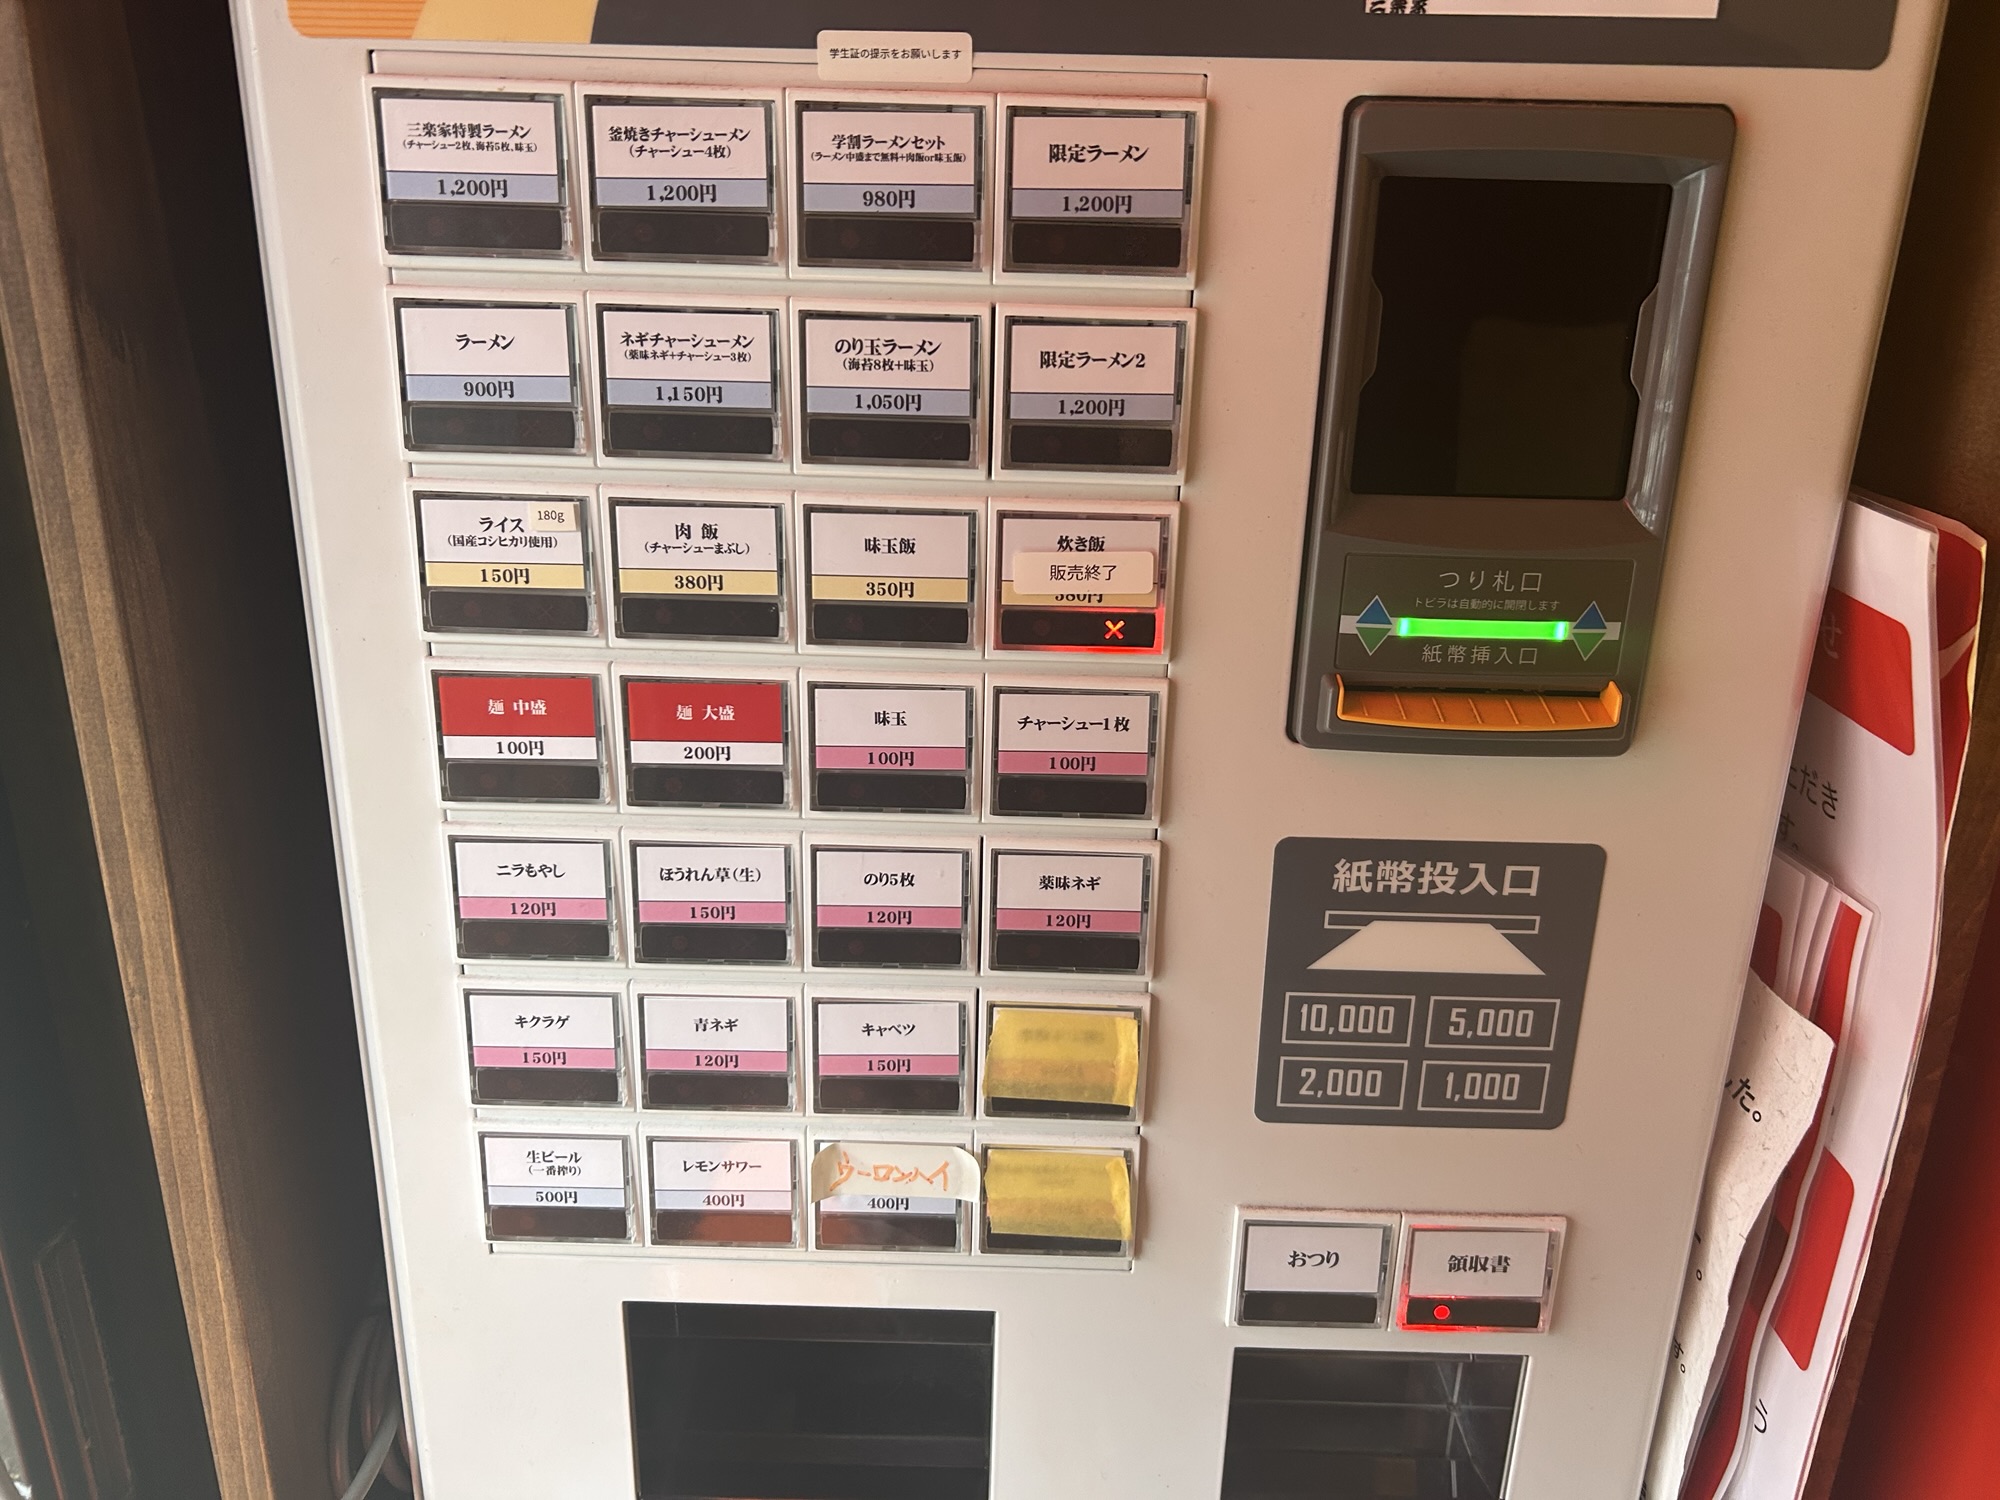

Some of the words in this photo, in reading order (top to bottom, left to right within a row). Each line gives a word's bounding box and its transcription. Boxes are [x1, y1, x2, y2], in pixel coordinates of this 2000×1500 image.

[829, 48, 962, 60] 学生証の提示をお願いします
[407, 122, 532, 141] 三楽家特製ラーメン
[608, 126, 751, 143] 釜焼きチャーシューメン
[831, 134, 947, 150] 学割ラーメンセット
[629, 144, 732, 160] （チャーシュー4枚）
[1048, 143, 1150, 164] 限定ラーメン
[438, 178, 508, 199] 1,200円
[647, 184, 717, 203] 1,200円
[862, 189, 916, 209] 980円
[1062, 195, 1132, 214] 1,200円
[455, 333, 516, 351] ラーメン
[620, 331, 755, 349] ネギチャーシューメン
[834, 337, 943, 357] のり玉ラーメン
[1039, 351, 1146, 369] 限定ラーメン2
[463, 380, 515, 399] 900円
[655, 385, 723, 404] 1,150円
[855, 393, 922, 412] 1,050円
[1058, 398, 1125, 417] 1,200円
[537, 509, 565, 523] 180g
[478, 516, 525, 534] ライス
[447, 534, 558, 549] （国産コシヒカリ使用）
[644, 541, 750, 555] （チャーシューまぶし）
[864, 537, 916, 555] 味玉飯
[1057, 535, 1105, 552] 炊き飯
[480, 568, 530, 585] 150円
[1050, 563, 1117, 581] 販売終了
[674, 573, 724, 590] 380円
[866, 581, 915, 598] 350円
[1439, 570, 1542, 593] つり札口
[1414, 597, 1560, 612] トビラは自動的に開閉します
[1421, 643, 1538, 665] 紙幣挿入口
[513, 699, 548, 716] 中盛
[702, 704, 736, 721] 大盛
[874, 710, 908, 727] 味玉
[1017, 715, 1130, 733] チャーシュー1枚
[496, 741, 544, 756] 100円
[684, 745, 731, 762] 200円
[867, 751, 915, 767] 100円
[1049, 755, 1096, 772] 100円
[496, 863, 566, 879] ニラもやし
[660, 867, 762, 883] ほうれん草（生）
[1332, 858, 1541, 897] 紙幣投入口
[863, 872, 915, 888] のり5枚
[1039, 875, 1101, 891] 薬味ネギ
[510, 901, 557, 917] 120円
[690, 904, 736, 921] 150円
[866, 910, 913, 925] 120円
[1045, 913, 1092, 929] 120円
[514, 1015, 571, 1029] キクラゲ
[693, 1017, 739, 1033] 青ネギ
[1300, 1003, 1395, 1035] 10,000
[1448, 1007, 1534, 1038] 5,000
[861, 1022, 916, 1037] キャベツ
[522, 1051, 567, 1066] 150円
[694, 1054, 739, 1068] 120円
[867, 1058, 911, 1073] 150円
[1299, 1066, 1383, 1098] 2,000
[1445, 1071, 1520, 1102] 1,000
[1725, 1078, 1762, 1123] た。
[526, 1150, 582, 1165] 生ビール
[528, 1165, 582, 1177] （一番搾り）
[683, 1160, 762, 1173] レモンサワー
[829, 1151, 950, 1192] ウーロンハイ
[535, 1190, 578, 1204] 500円
[702, 1193, 745, 1207] 400円
[867, 1197, 909, 1211] 400円
[1287, 1250, 1340, 1269] おつり
[1447, 1254, 1511, 1274] 領収書
